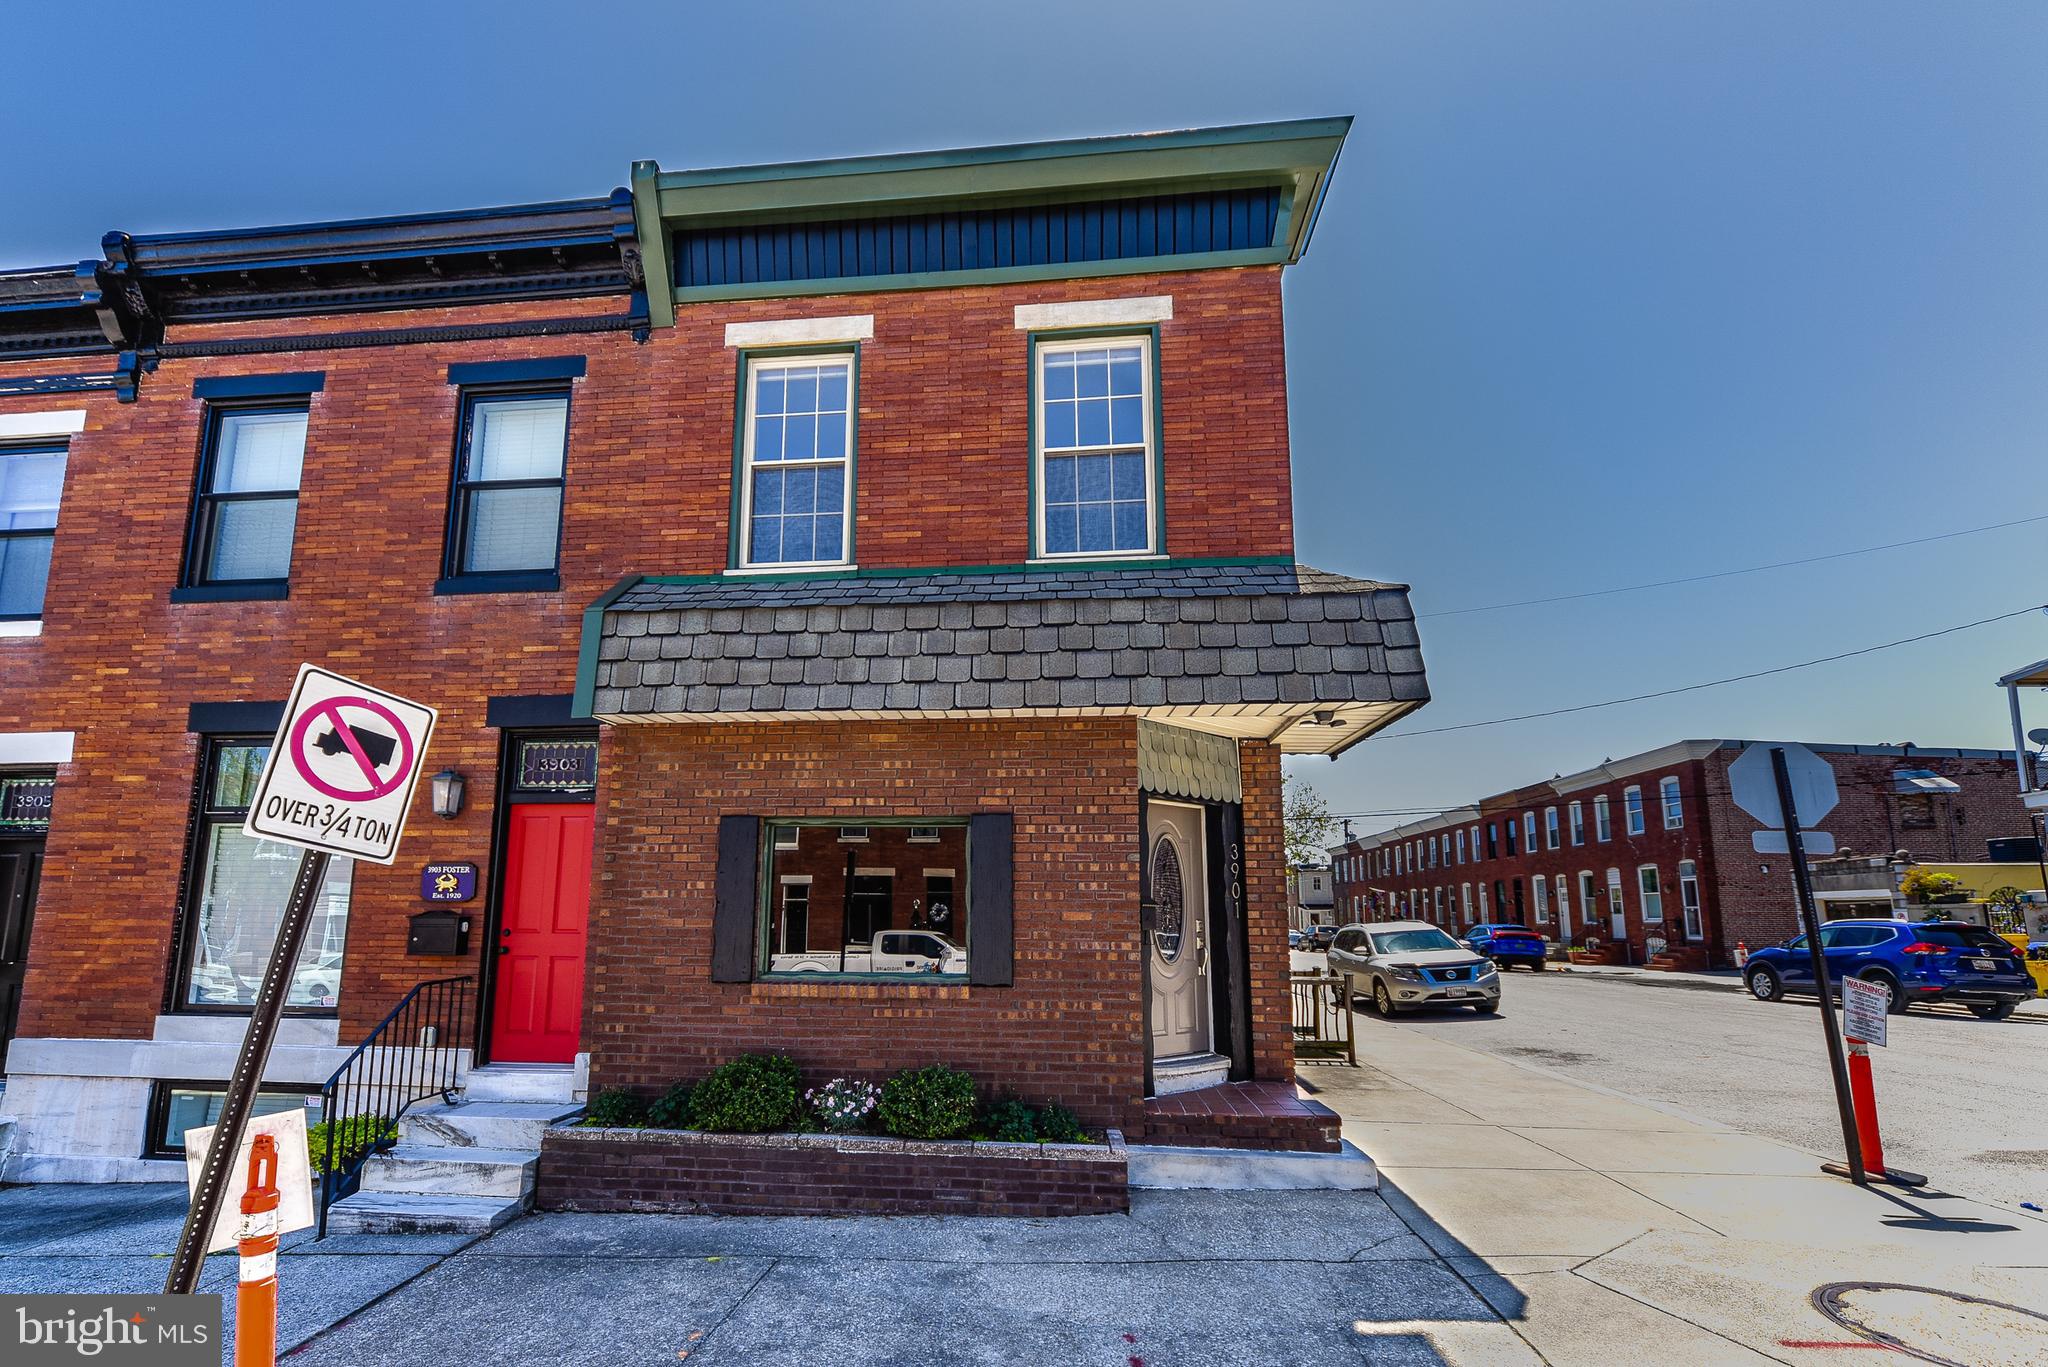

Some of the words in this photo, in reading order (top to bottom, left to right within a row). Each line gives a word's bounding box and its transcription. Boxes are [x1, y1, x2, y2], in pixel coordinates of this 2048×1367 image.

[539, 758, 578, 771] 3903
[16, 795, 52, 807] 3905
[265, 795, 320, 828] OVER
[319, 804, 350, 838] 3/4
[353, 816, 392, 845] TON
[427, 866, 442, 874] 3903
[442, 866, 470, 874] FOSTER
[1231, 843, 1240, 919] 3901
[1846, 979, 1886, 998] WARNING!
